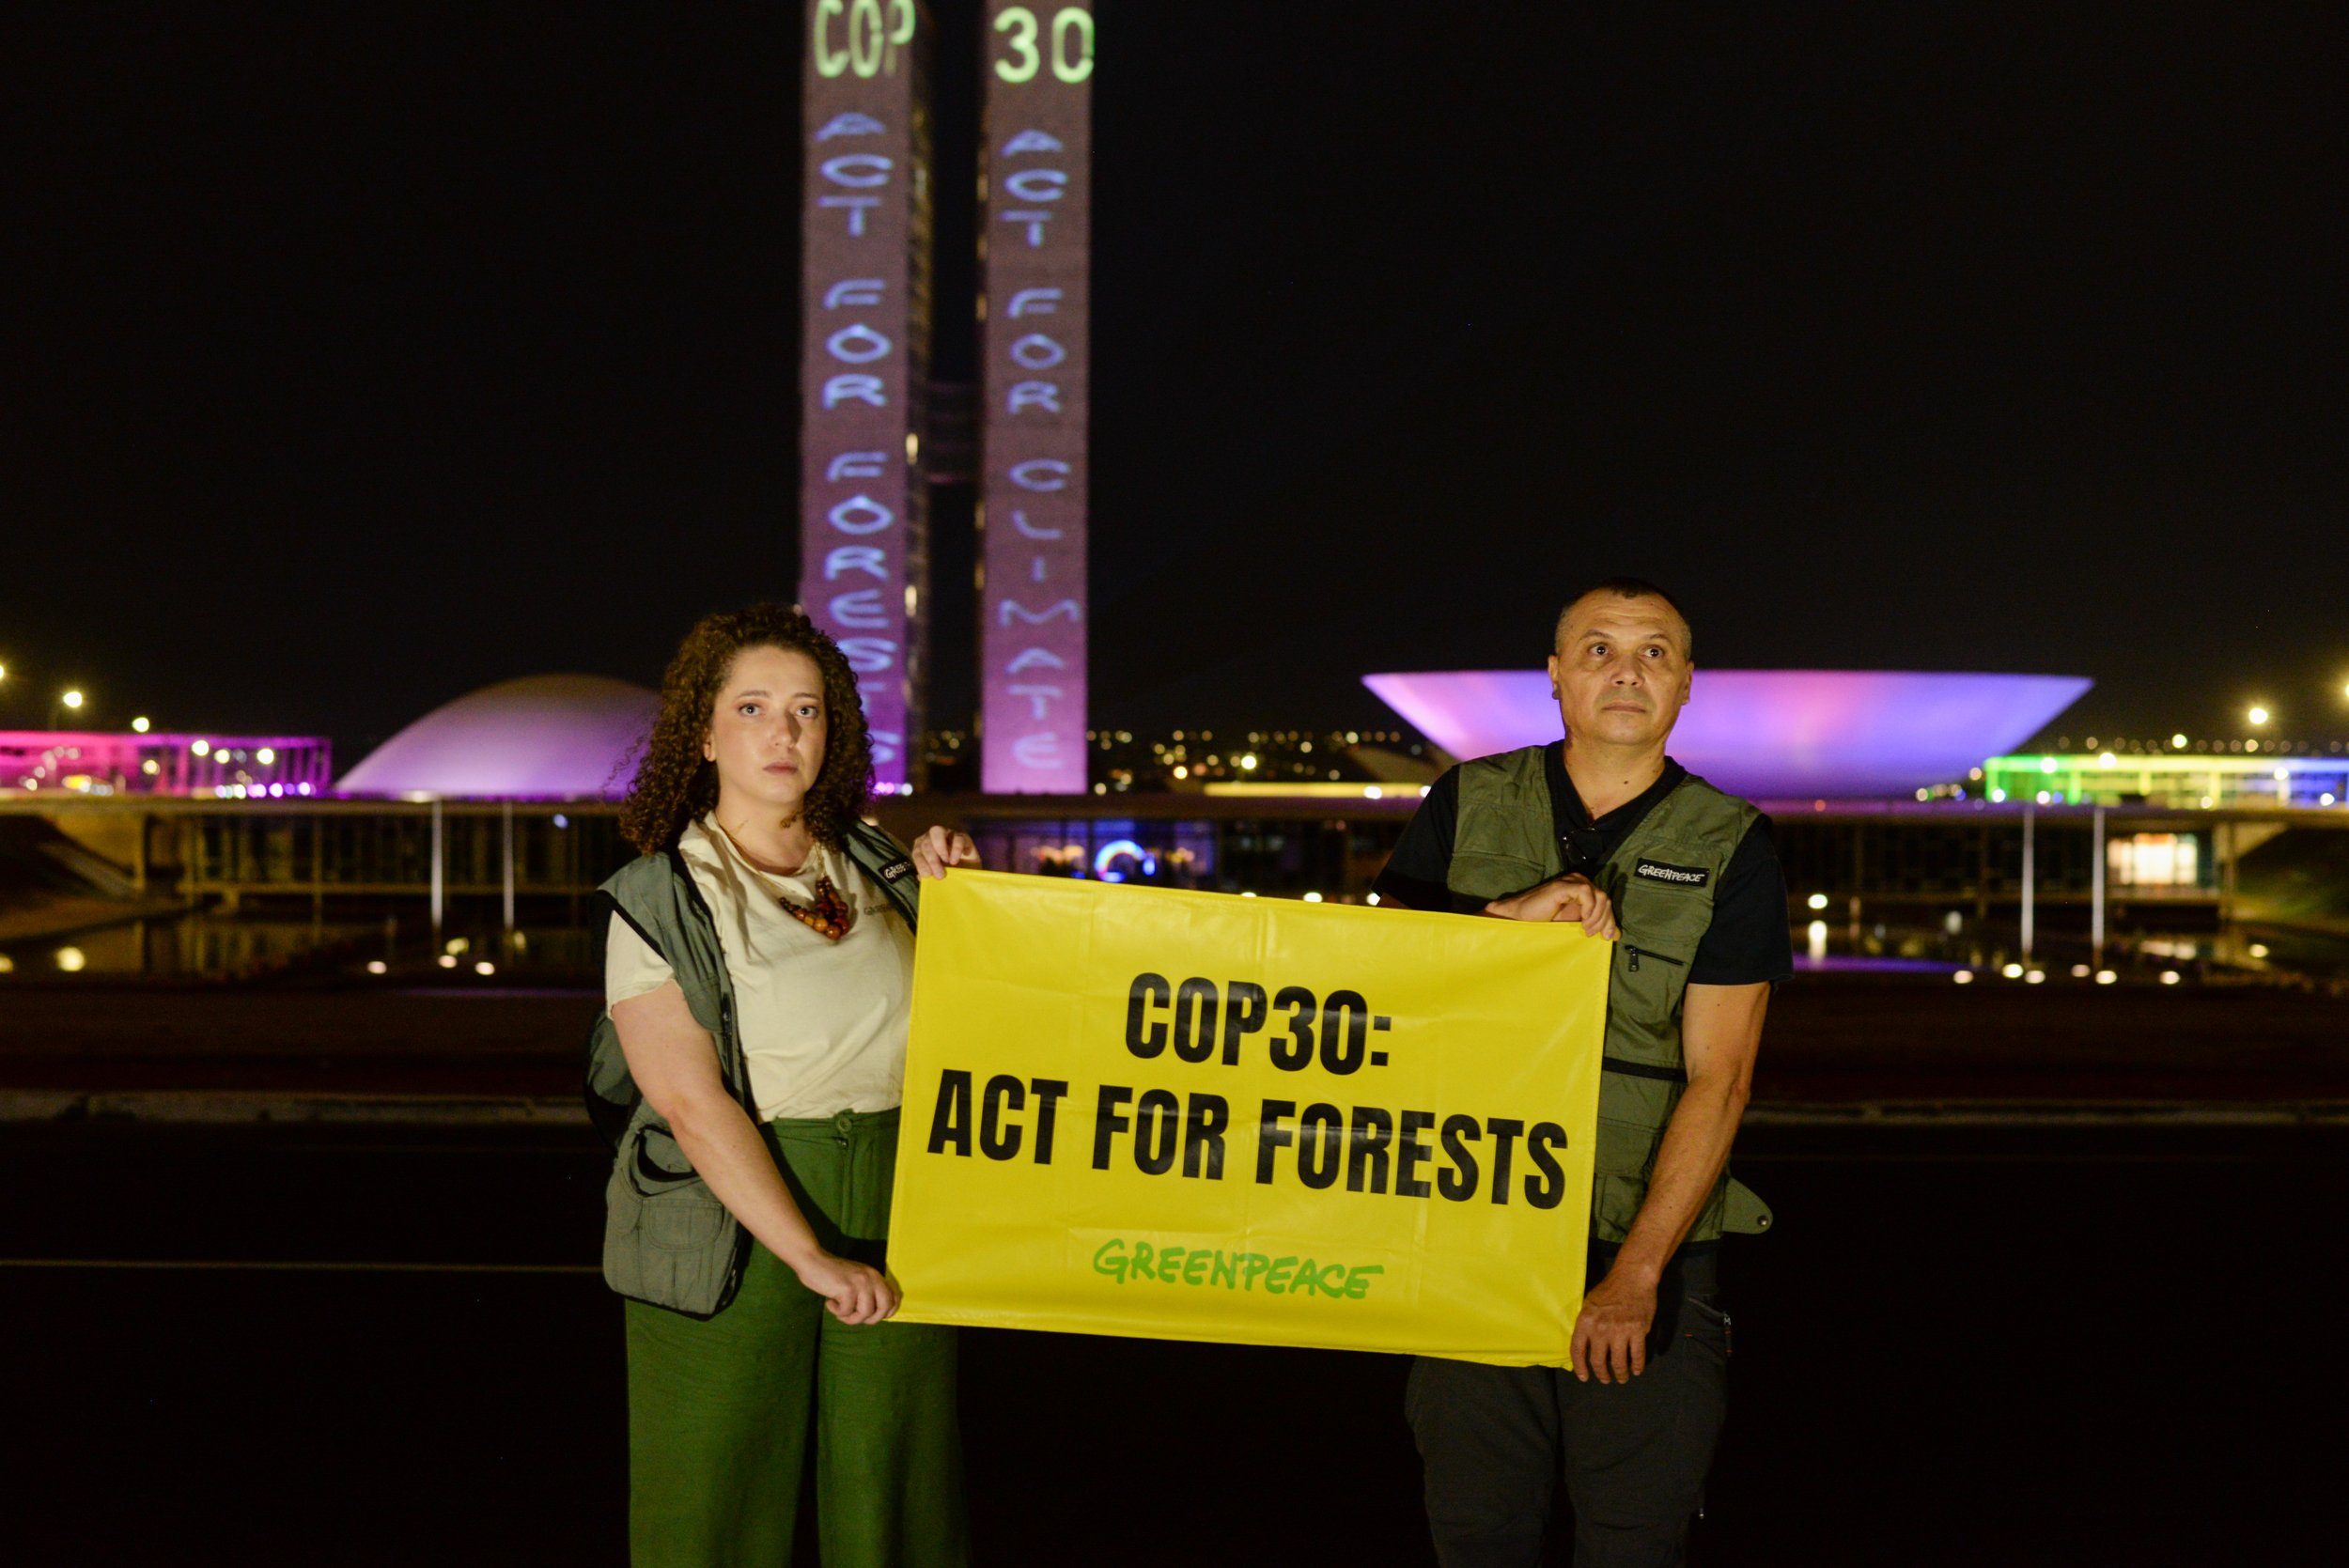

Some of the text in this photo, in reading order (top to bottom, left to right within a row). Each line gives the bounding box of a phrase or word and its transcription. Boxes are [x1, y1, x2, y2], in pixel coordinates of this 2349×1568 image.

[814, 0, 1094, 84] COP 30
[815, 112, 894, 237] ACT
[823, 279, 893, 410] FOR
[999, 130, 1081, 769] ACT FOR CLIMATE
[1638, 863, 1705, 883] GREENPEACE
[1126, 972, 1392, 1076] COP30:
[927, 1069, 1568, 1210] ACT FOR FORESTS
[1093, 1238, 1384, 1299] GREENPEACE
